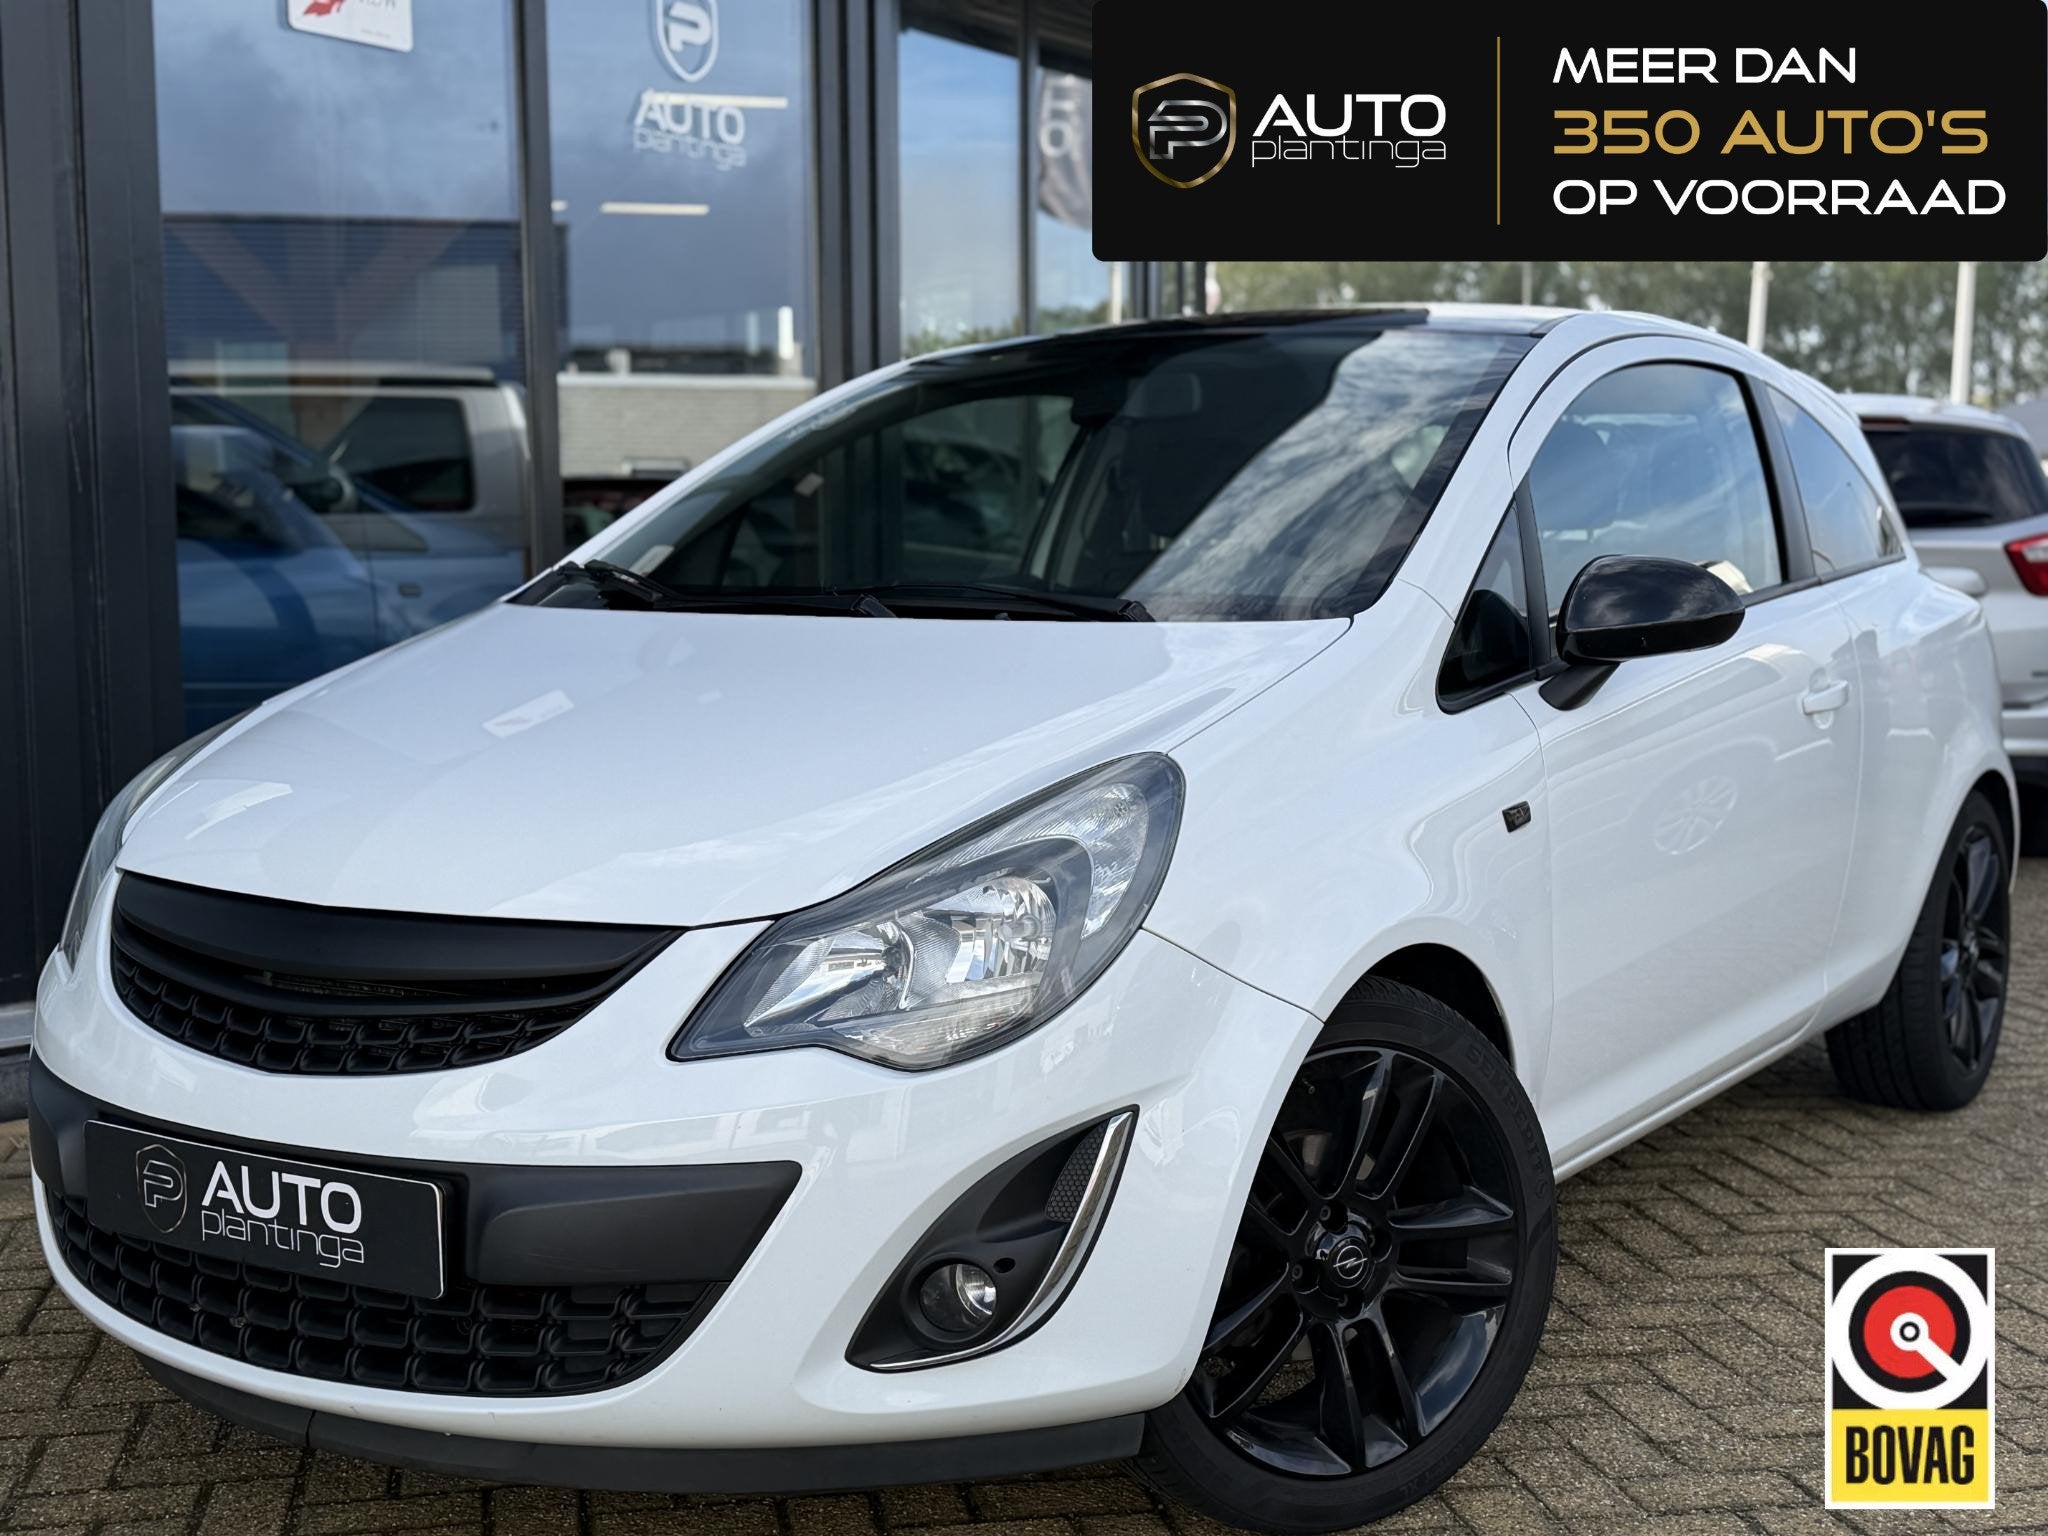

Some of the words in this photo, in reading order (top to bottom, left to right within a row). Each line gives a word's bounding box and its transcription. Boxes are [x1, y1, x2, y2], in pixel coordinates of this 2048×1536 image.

[634, 89, 746, 145] AUTO
[201, 1160, 363, 1234] AUTO
[201, 1208, 365, 1268] plantinga
